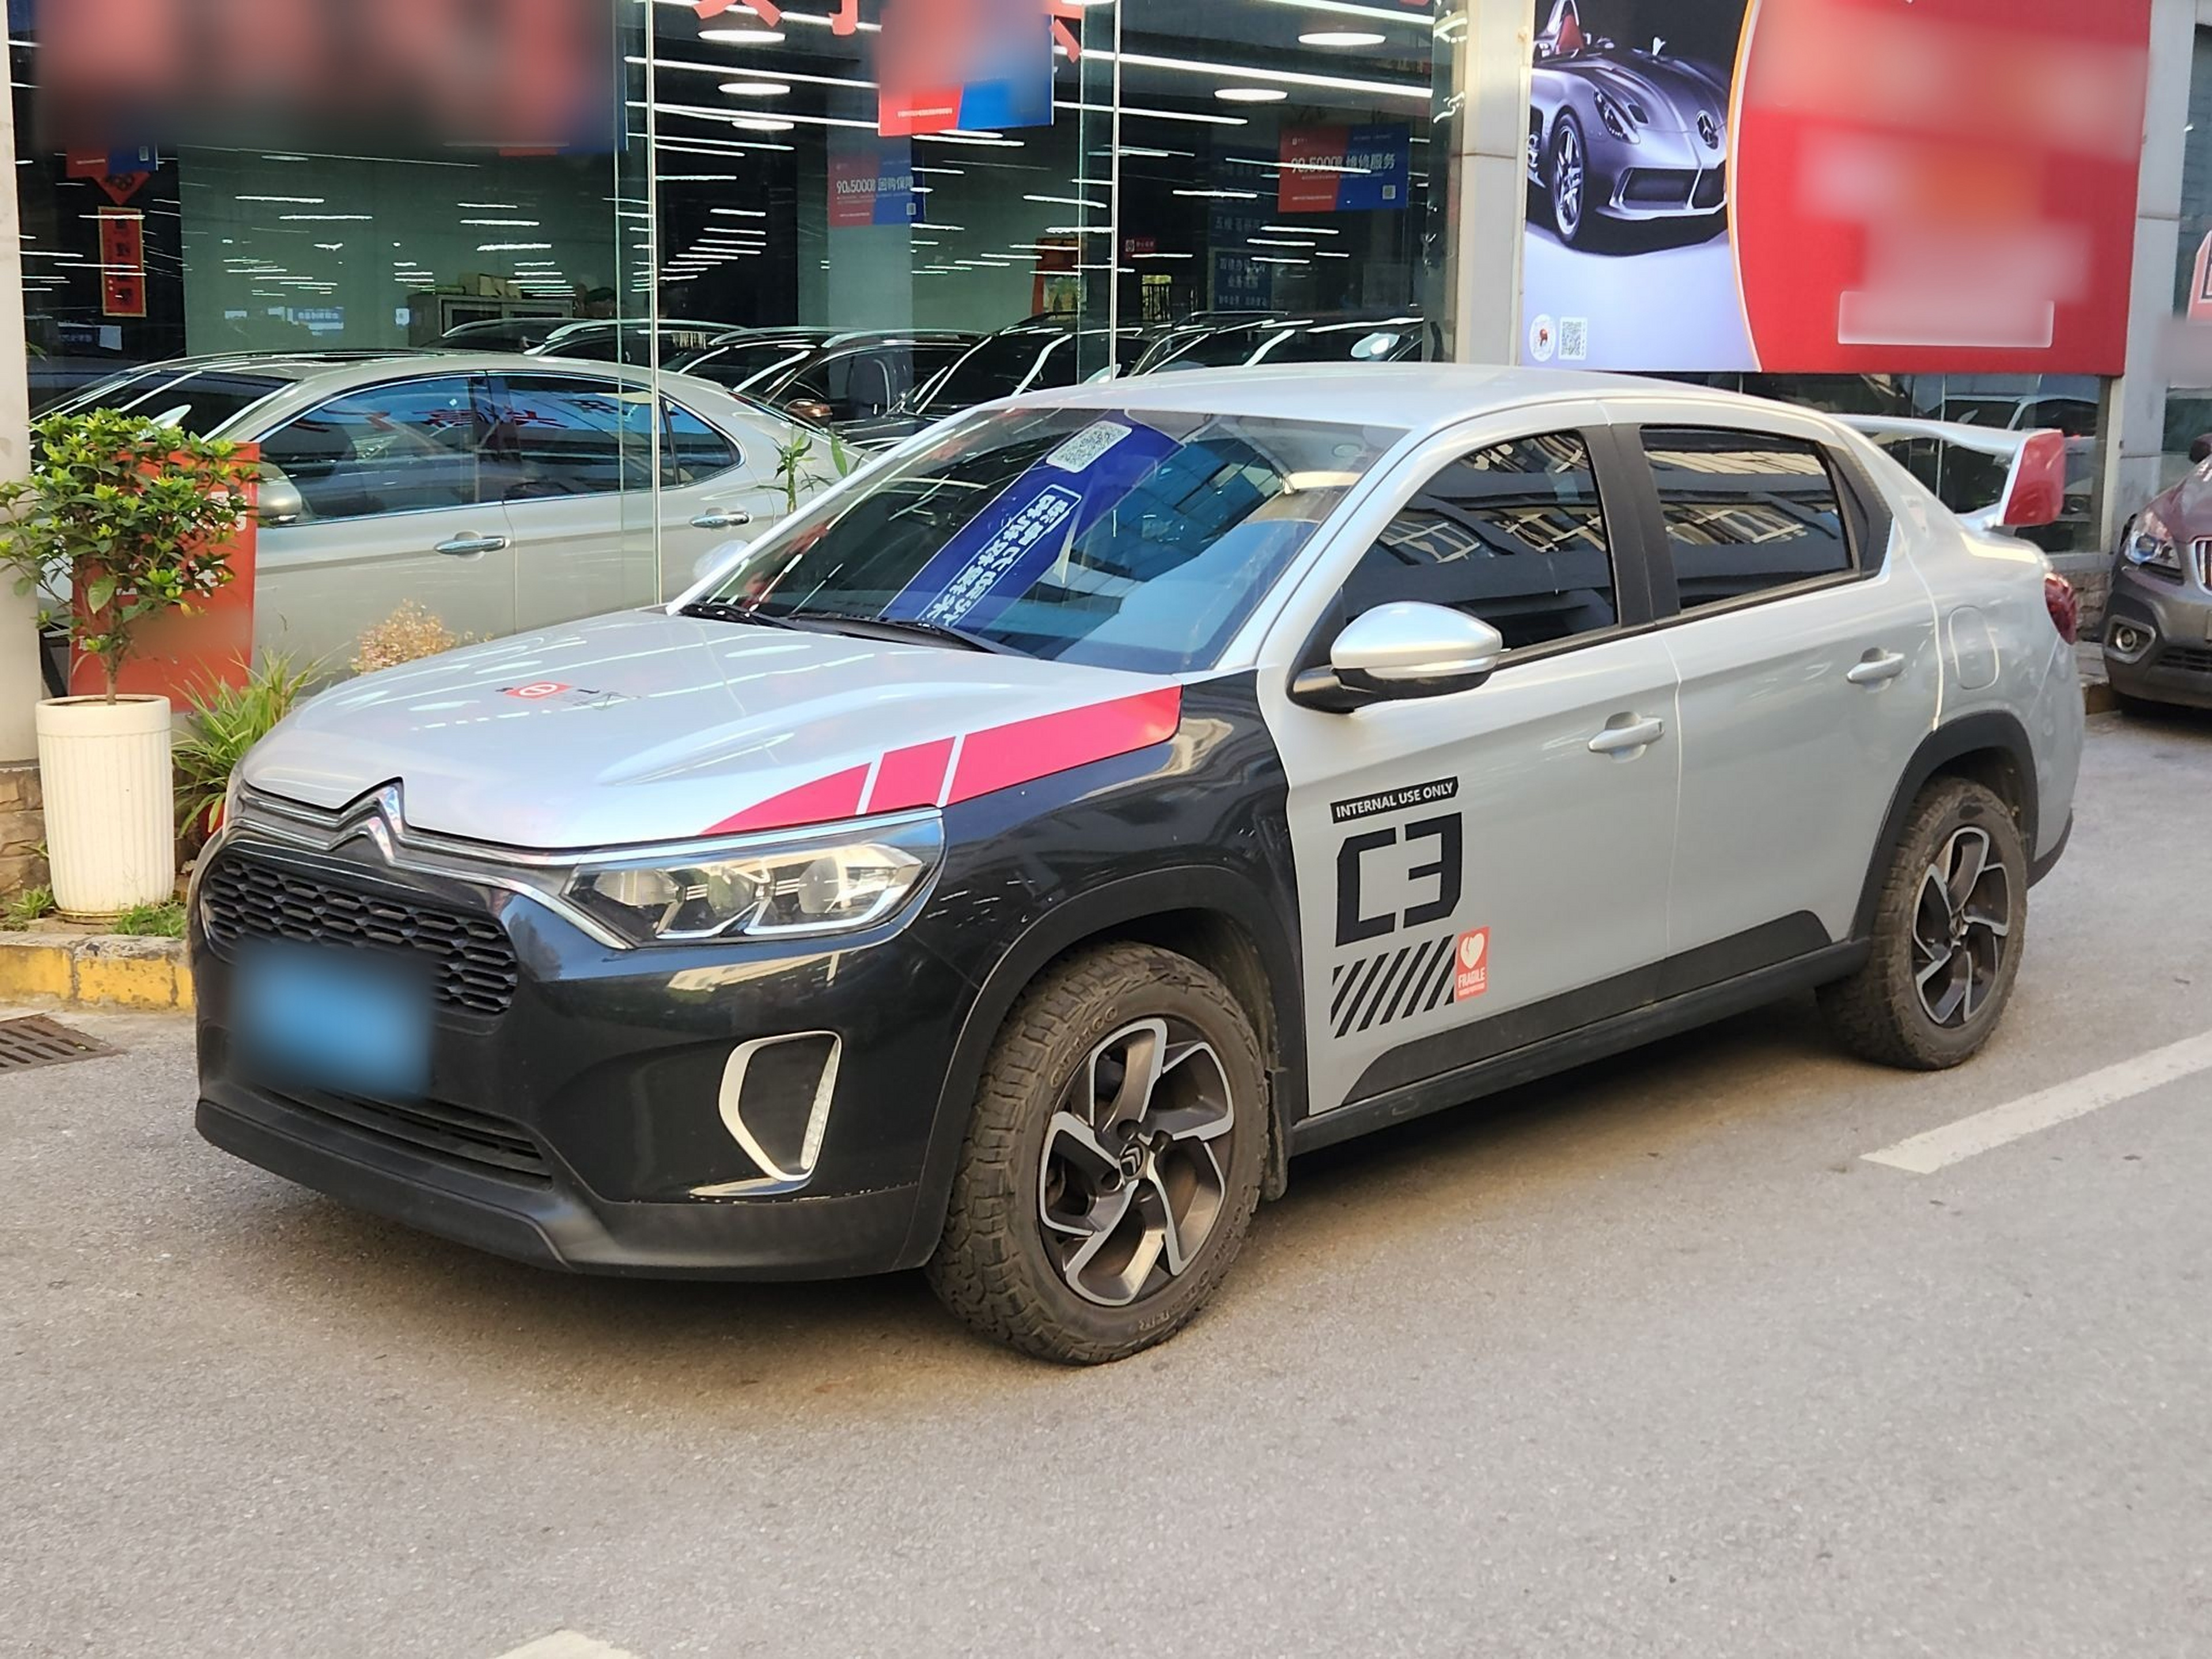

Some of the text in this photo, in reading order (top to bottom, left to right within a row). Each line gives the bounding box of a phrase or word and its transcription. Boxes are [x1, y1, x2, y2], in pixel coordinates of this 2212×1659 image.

[1336, 782, 1453, 819] INTERNAL USE ONLY
[1335, 812, 1462, 948] C3
[1457, 967, 1486, 989] FRAGILE
